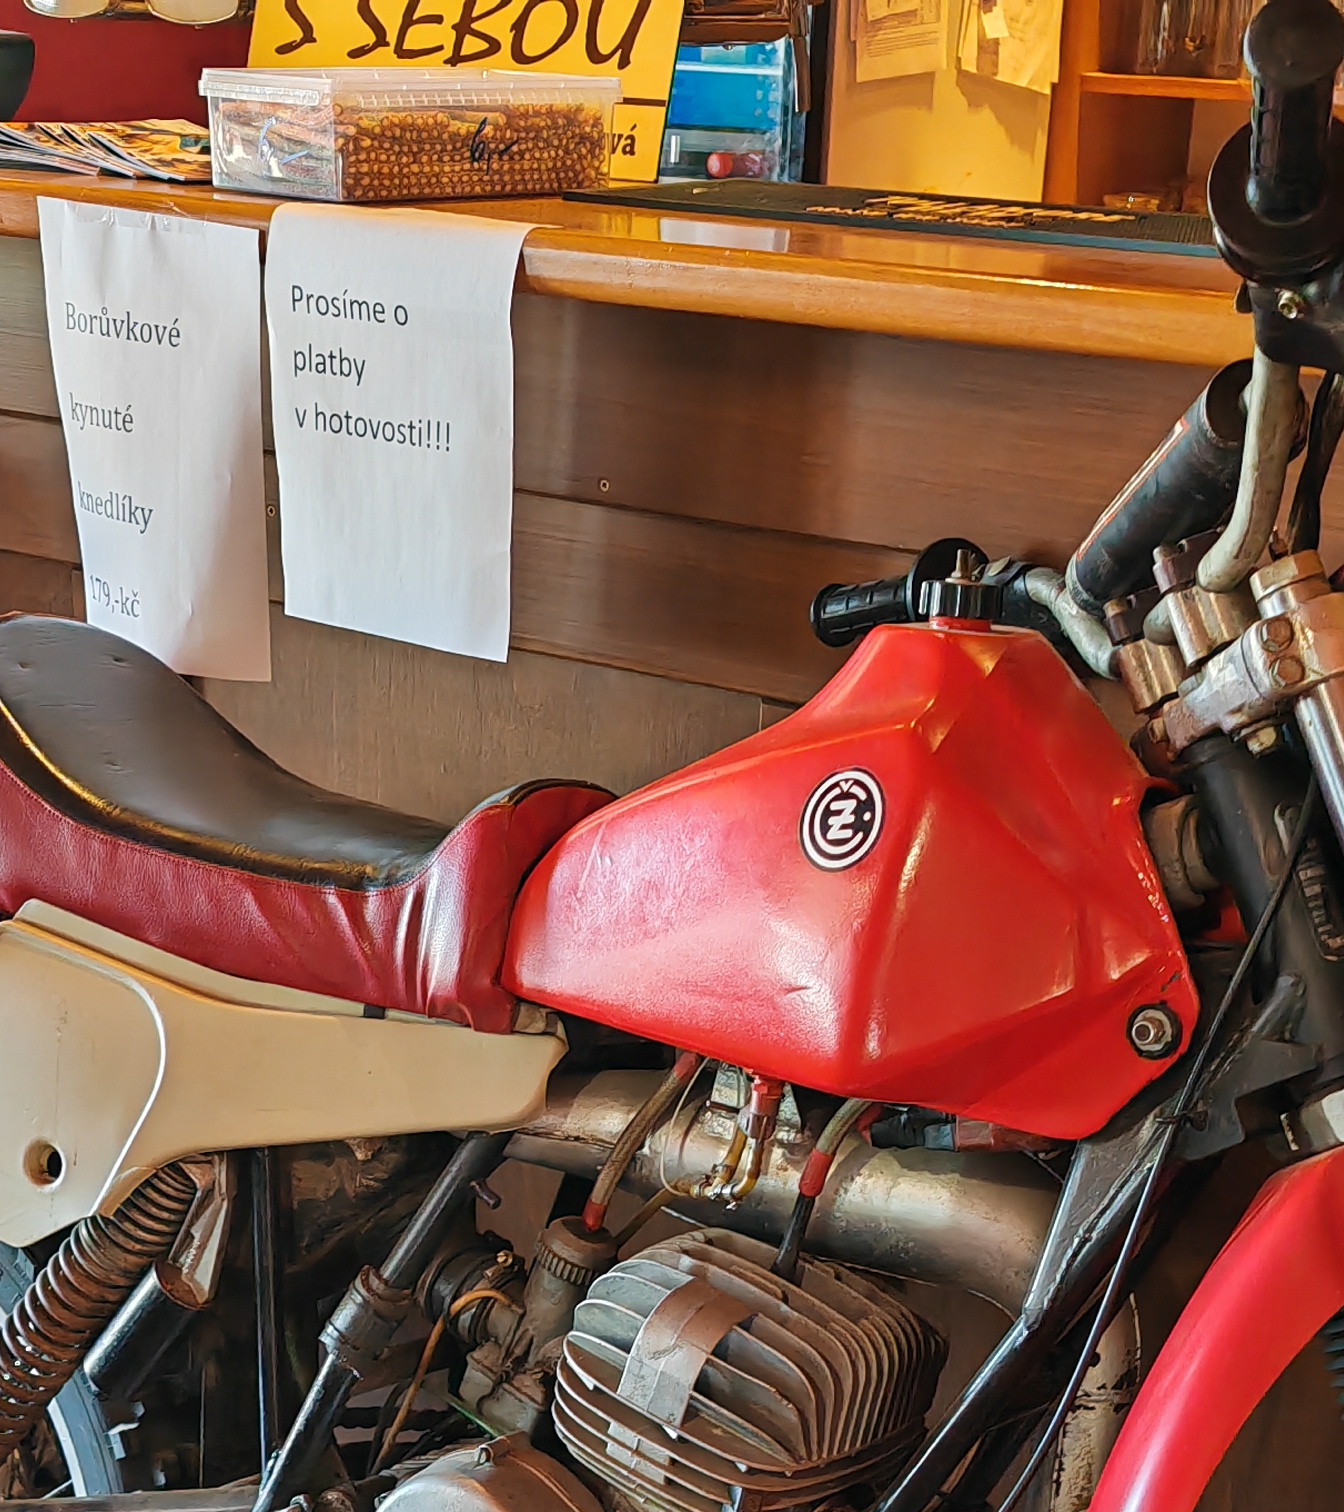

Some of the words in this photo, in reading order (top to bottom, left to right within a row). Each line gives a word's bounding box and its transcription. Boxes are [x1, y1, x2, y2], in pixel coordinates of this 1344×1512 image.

[64, 302, 181, 348] Borůvkové
[291, 284, 386, 324] Prosíme
[394, 304, 409, 326] o
[293, 343, 366, 387] platby
[69, 392, 134, 434] kynuté
[294, 406, 307, 429] v
[314, 402, 451, 452] hotovosti!!!
[77, 480, 154, 534] knedlíky
[89, 574, 140, 618] 179,-kč
